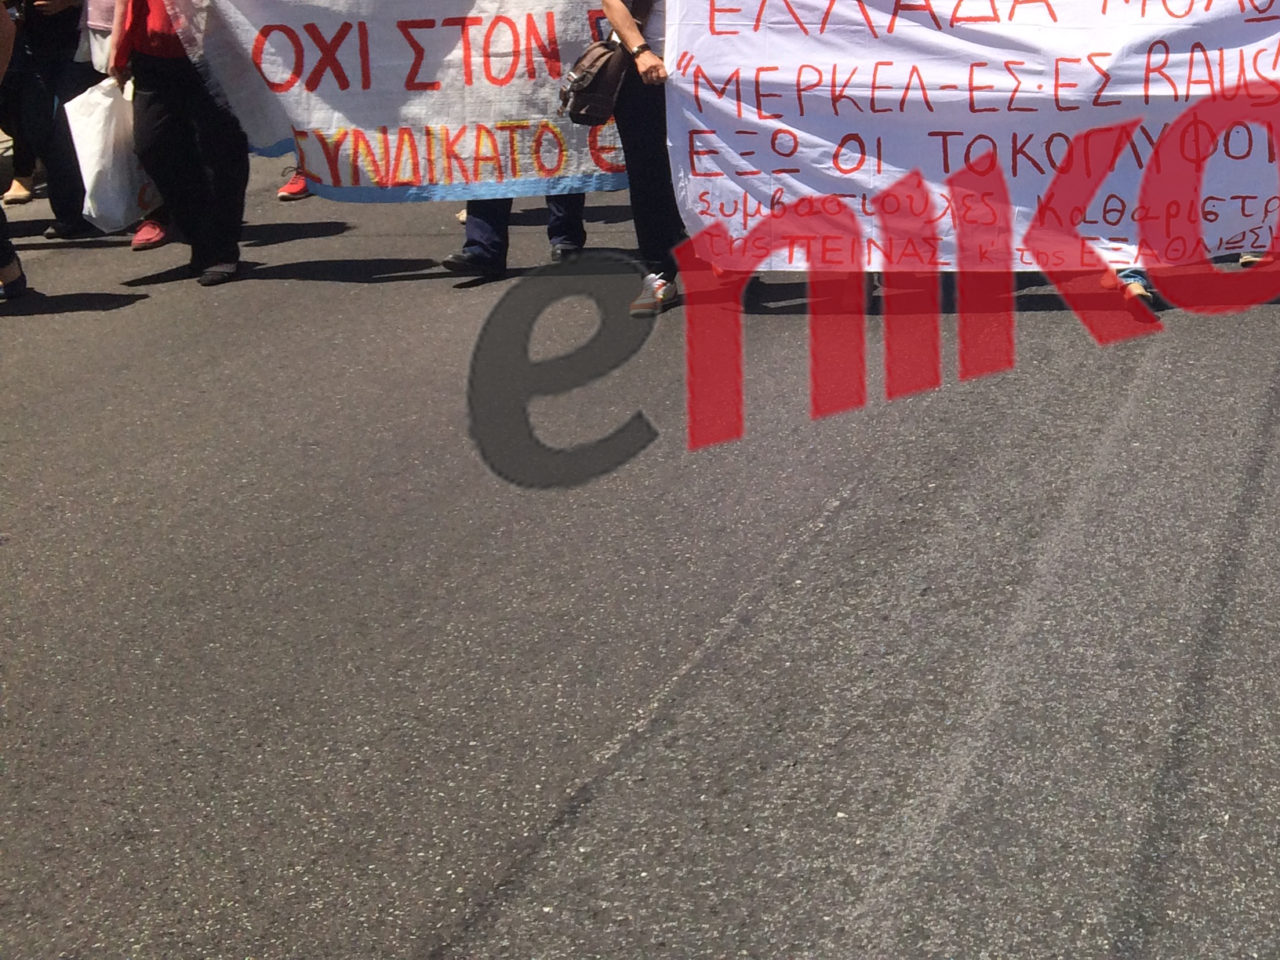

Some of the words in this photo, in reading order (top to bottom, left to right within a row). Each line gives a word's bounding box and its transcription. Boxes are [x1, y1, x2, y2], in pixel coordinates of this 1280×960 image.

[252, 21, 371, 92] ΟΧΙ
[396, 10, 562, 91] ΣΤΟΝ
[689, 128, 800, 177] ΕΞΩ
[832, 133, 882, 175] ΟΙ
[927, 111, 1276, 177] ΤΟΚΟΓΛΥΦΟΙ
[780, 234, 950, 265] ΠΕΙΝΑΣ
